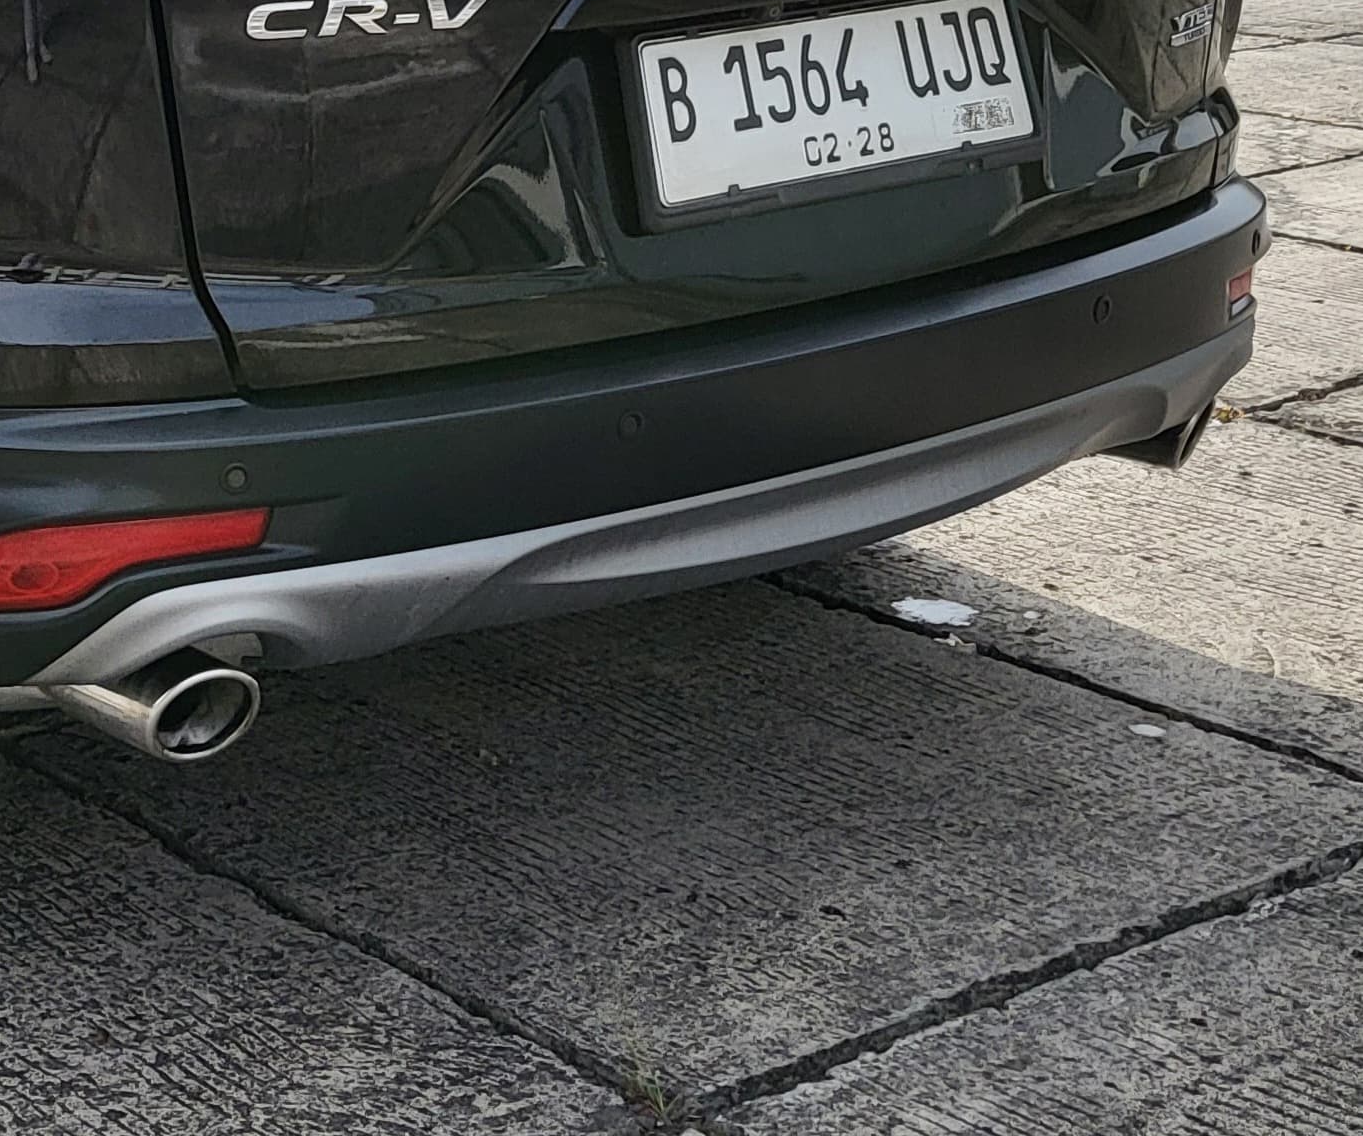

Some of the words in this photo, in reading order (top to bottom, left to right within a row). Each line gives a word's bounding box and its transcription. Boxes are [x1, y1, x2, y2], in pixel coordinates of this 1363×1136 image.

[658, 56, 697, 143] B
[723, 28, 869, 132] 1564
[895, 6, 1011, 98] UJQ
